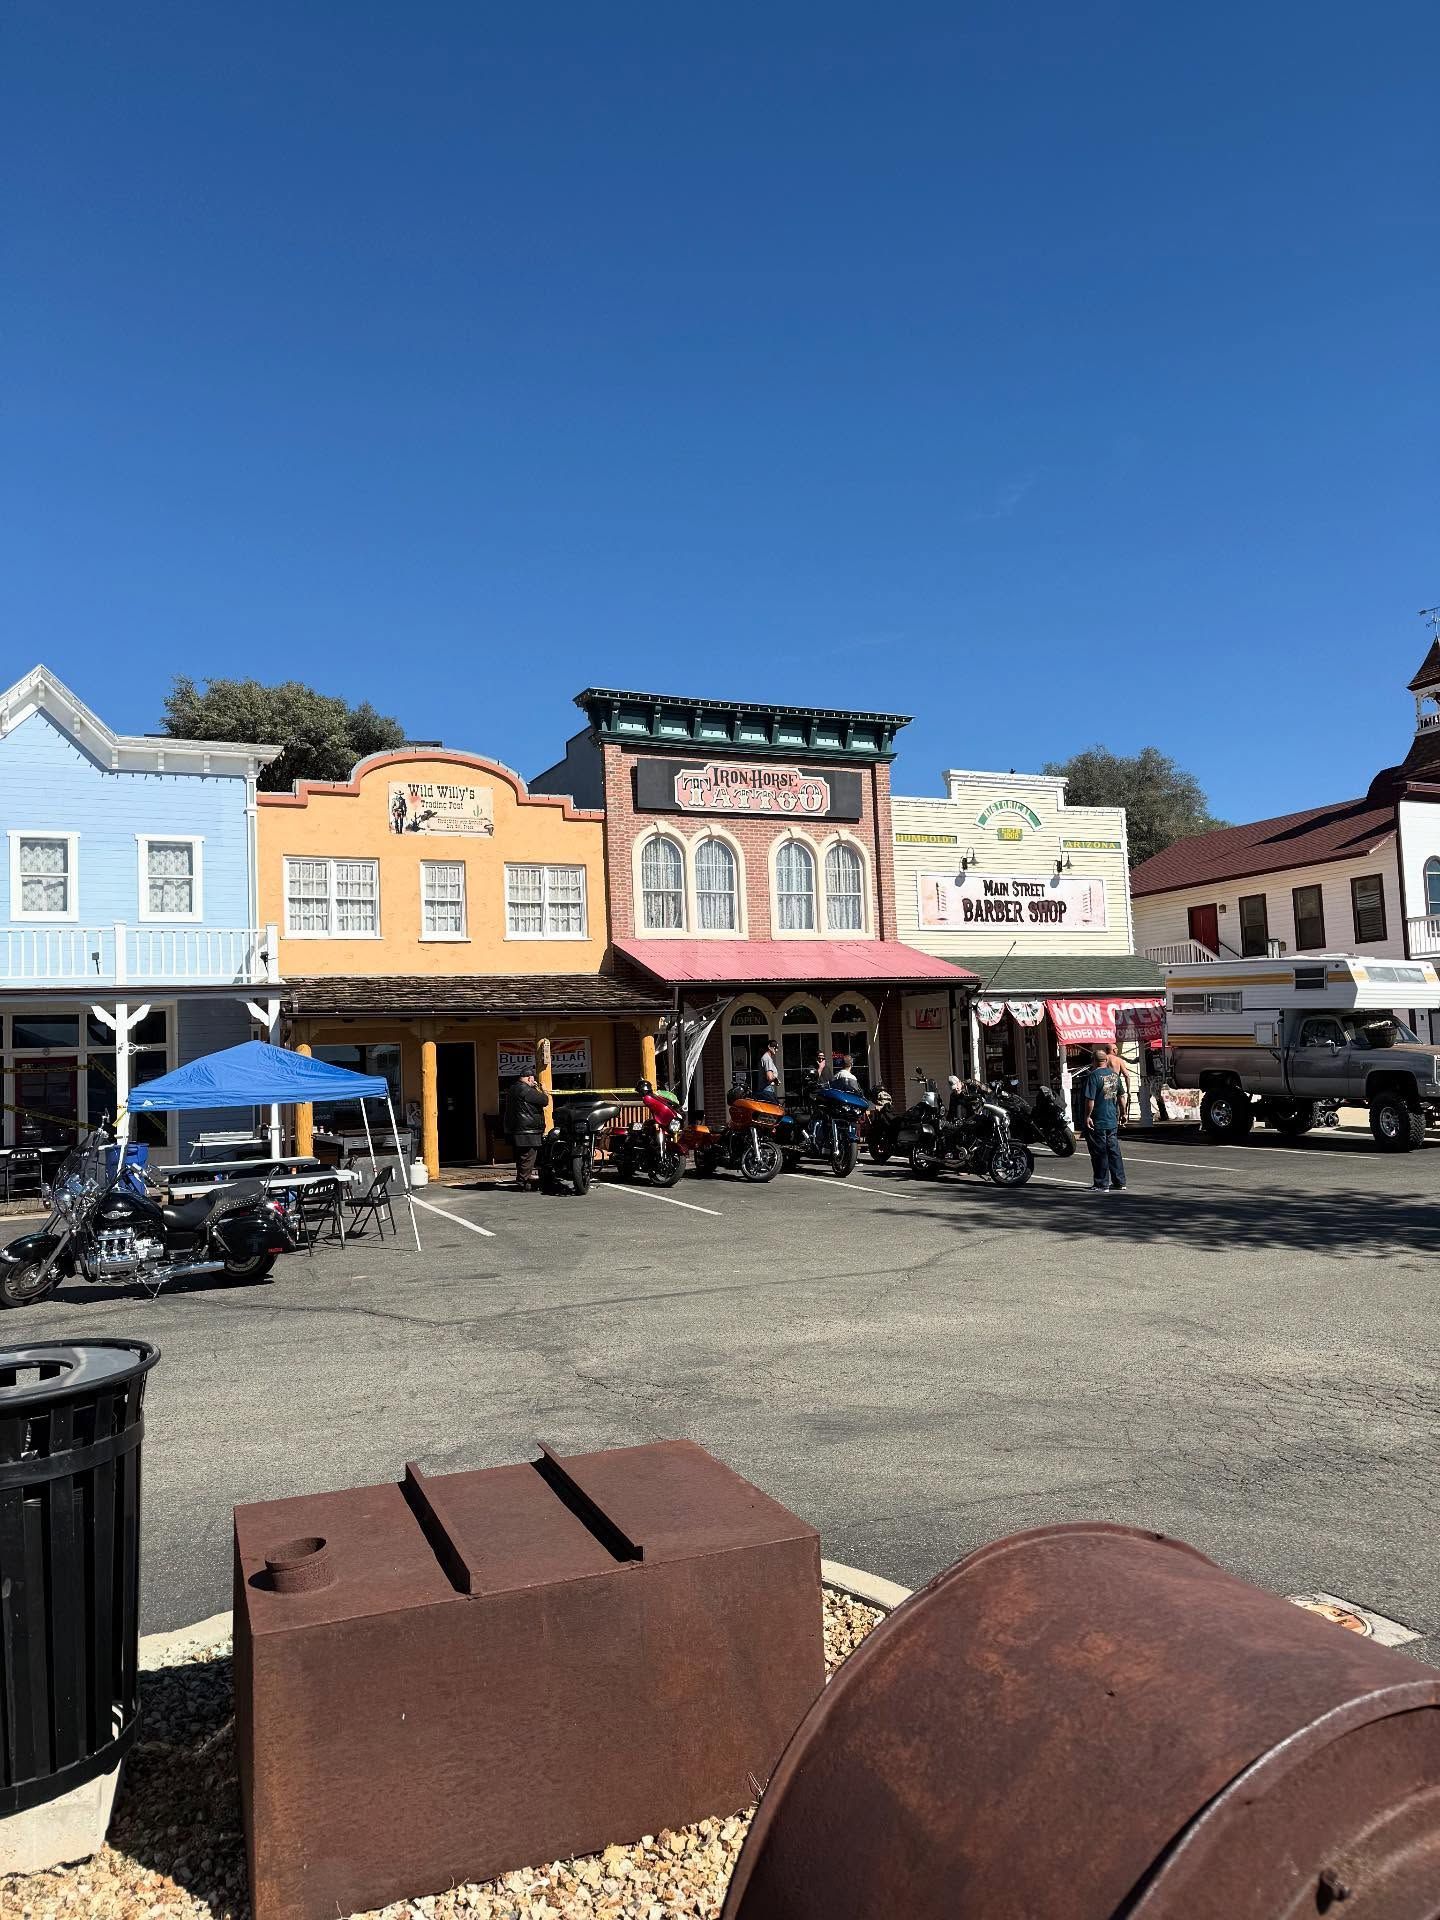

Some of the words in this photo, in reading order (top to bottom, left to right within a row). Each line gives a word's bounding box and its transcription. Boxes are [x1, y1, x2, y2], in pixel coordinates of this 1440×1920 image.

[712, 767, 750, 787] IRON
[750, 769, 798, 789] HORSE
[407, 783, 434, 798] Wild
[436, 785, 475, 802] Willy's
[682, 776, 824, 812] TATTOO
[420, 800, 447, 810] Trading
[896, 833, 956, 844] HUMBOLDT
[1065, 841, 1116, 849] ARIZONA
[982, 879, 1009, 897] MAIN
[1012, 881, 1045, 898] STREET
[962, 898, 1024, 923] BARBER
[1028, 900, 1067, 923] SHOP
[736, 1016, 761, 1025] OPEN
[1052, 1002, 1103, 1026] NOW
[1062, 1029, 1095, 1040] UNDER
[499, 1053, 533, 1064] BLUE
